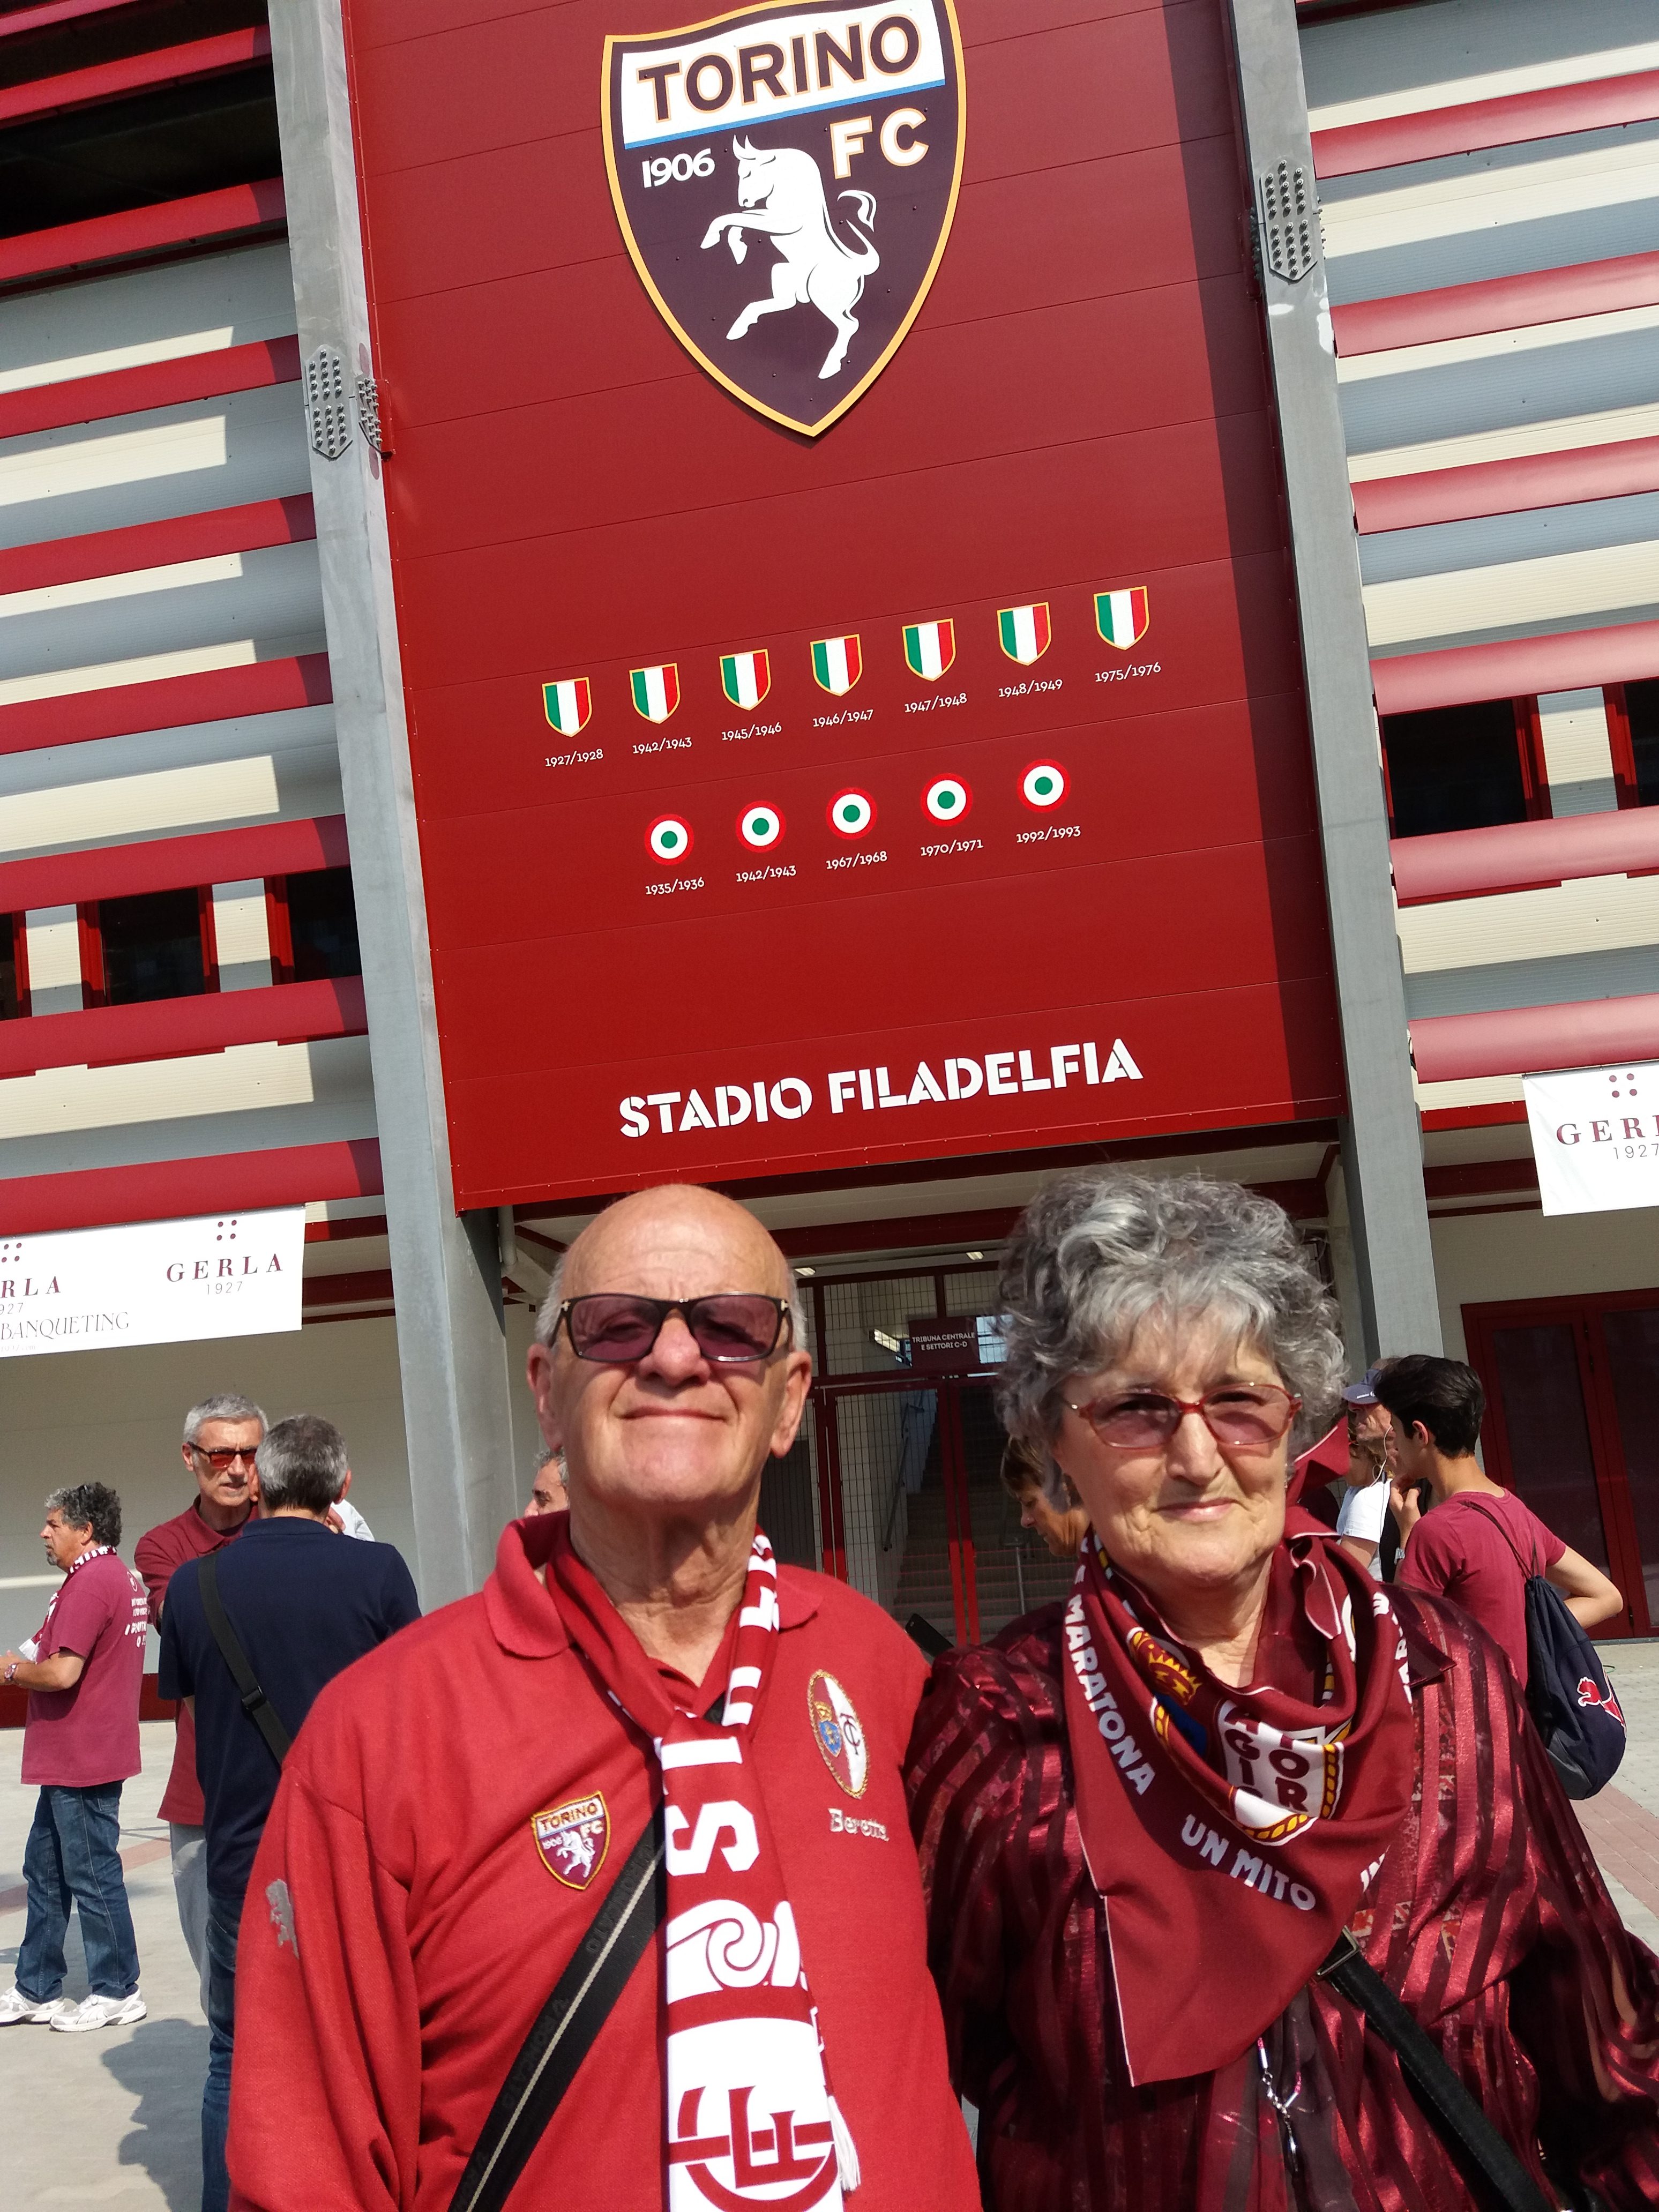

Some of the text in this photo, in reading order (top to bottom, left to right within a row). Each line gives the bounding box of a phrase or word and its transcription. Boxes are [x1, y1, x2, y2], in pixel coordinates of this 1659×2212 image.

[636, 13, 922, 123] TORINO
[829, 108, 929, 180] FC
[642, 148, 715, 188] 1906
[544, 662, 1161, 767] 1927/1928 1942/1943 1945/1946 1946/1947 1947/1948 1948/1949 1975/1976
[645, 826, 1081, 895] 1935/1936 1942/1943 1967/1968 1970/1971 1992/1993
[619, 1038, 1144, 1138] STADIO FILADELFIA
[1613, 1144, 1659, 1159] 1927
[166, 1253, 283, 1282] GERLA
[207, 1281, 243, 1295] 1927
[1, 1312, 129, 1340] BANQUETING
[912, 1332, 975, 1343] TRIBUNA CENTRALE
[926, 1342, 954, 1350] SETTORI
[1065, 1594, 1155, 1796] MARATONA
[539, 1803, 597, 1832] TORINO
[580, 1820, 604, 1839] FC
[1181, 1813, 1230, 1866] UN
[1230, 1848, 1316, 1911] MITO
